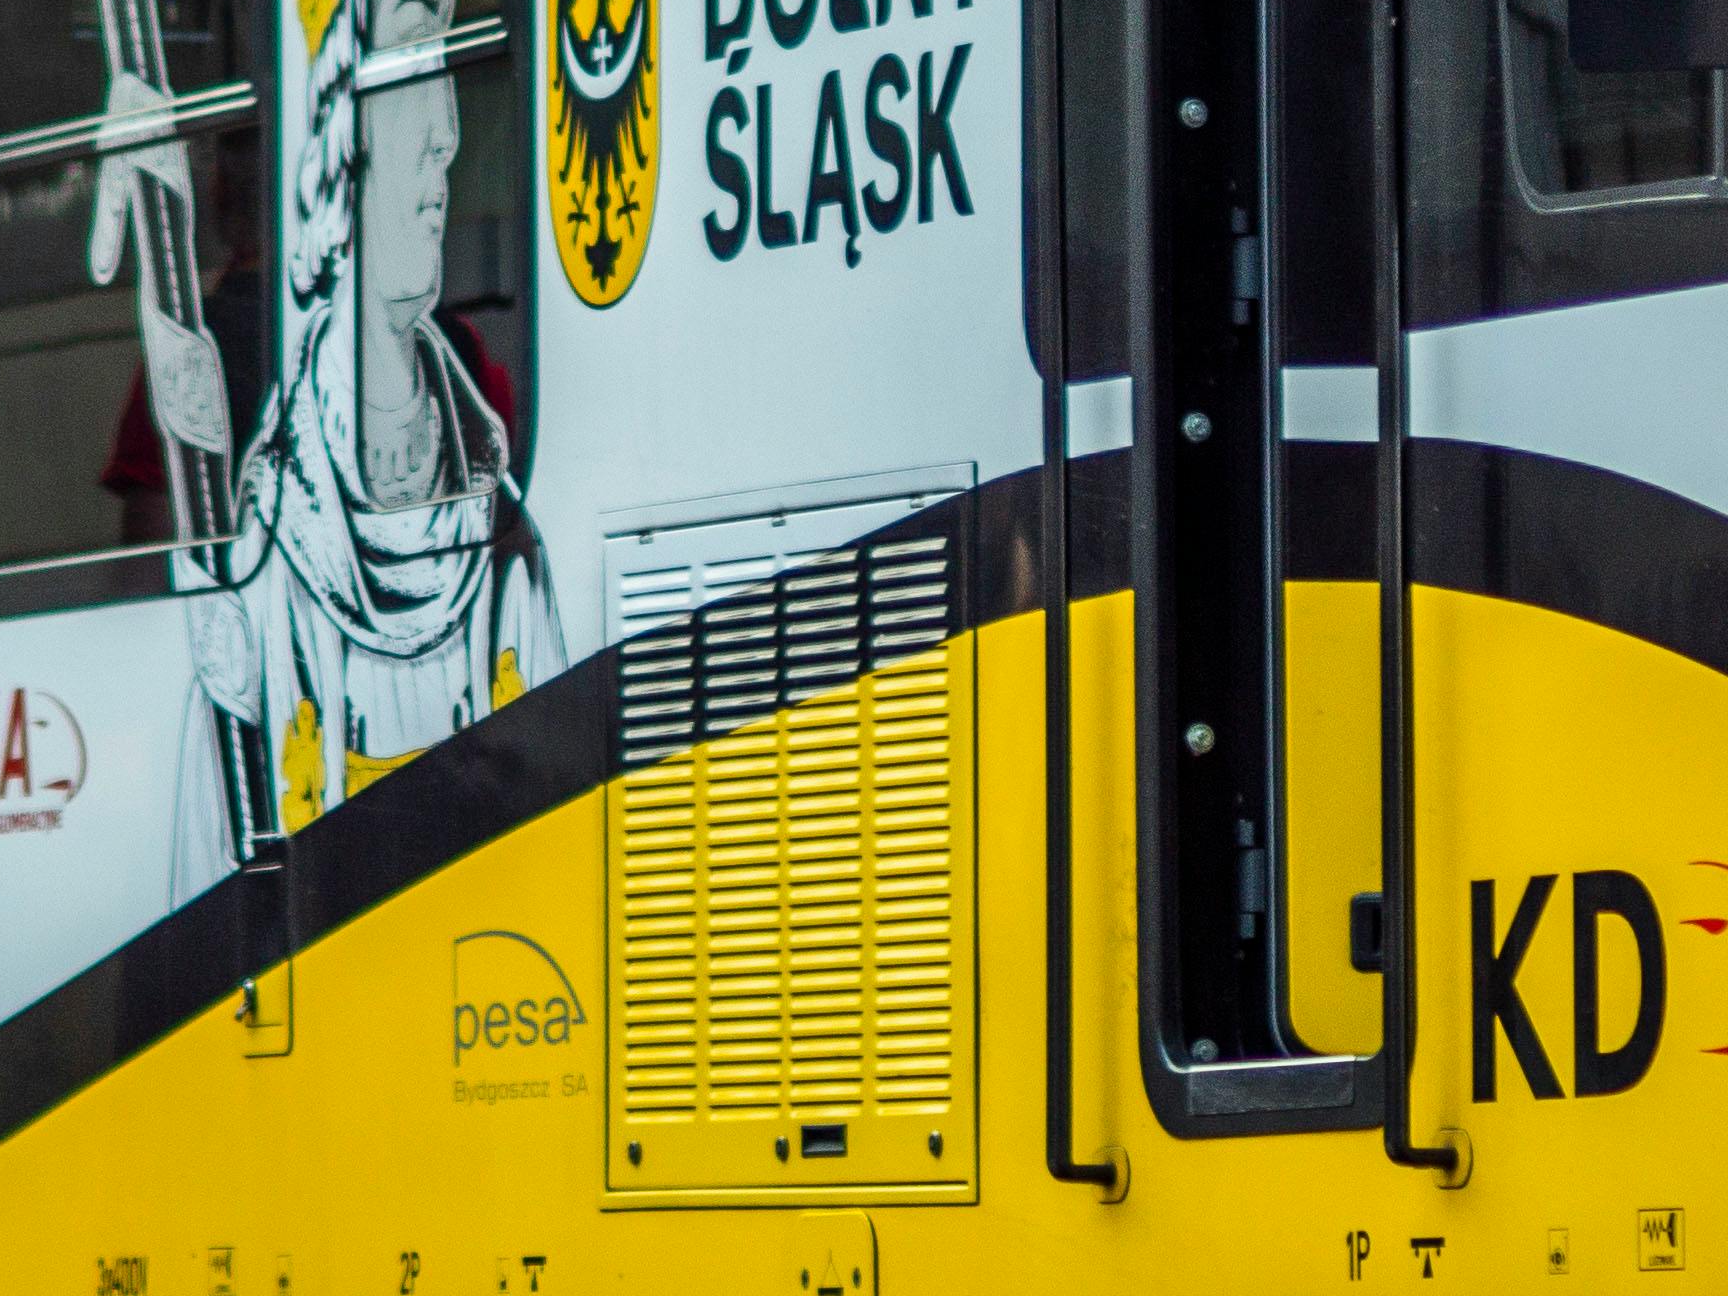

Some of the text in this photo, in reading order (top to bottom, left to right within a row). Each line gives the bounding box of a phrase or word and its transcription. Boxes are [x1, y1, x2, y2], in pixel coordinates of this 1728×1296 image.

[702, 44, 975, 270] ŚLĄSK
[1471, 869, 1668, 1103] KD
[453, 996, 572, 1068] pesa
[561, 1074, 589, 1098] SA
[400, 1252, 420, 1295] 2P
[1346, 1231, 1370, 1280] 1P
